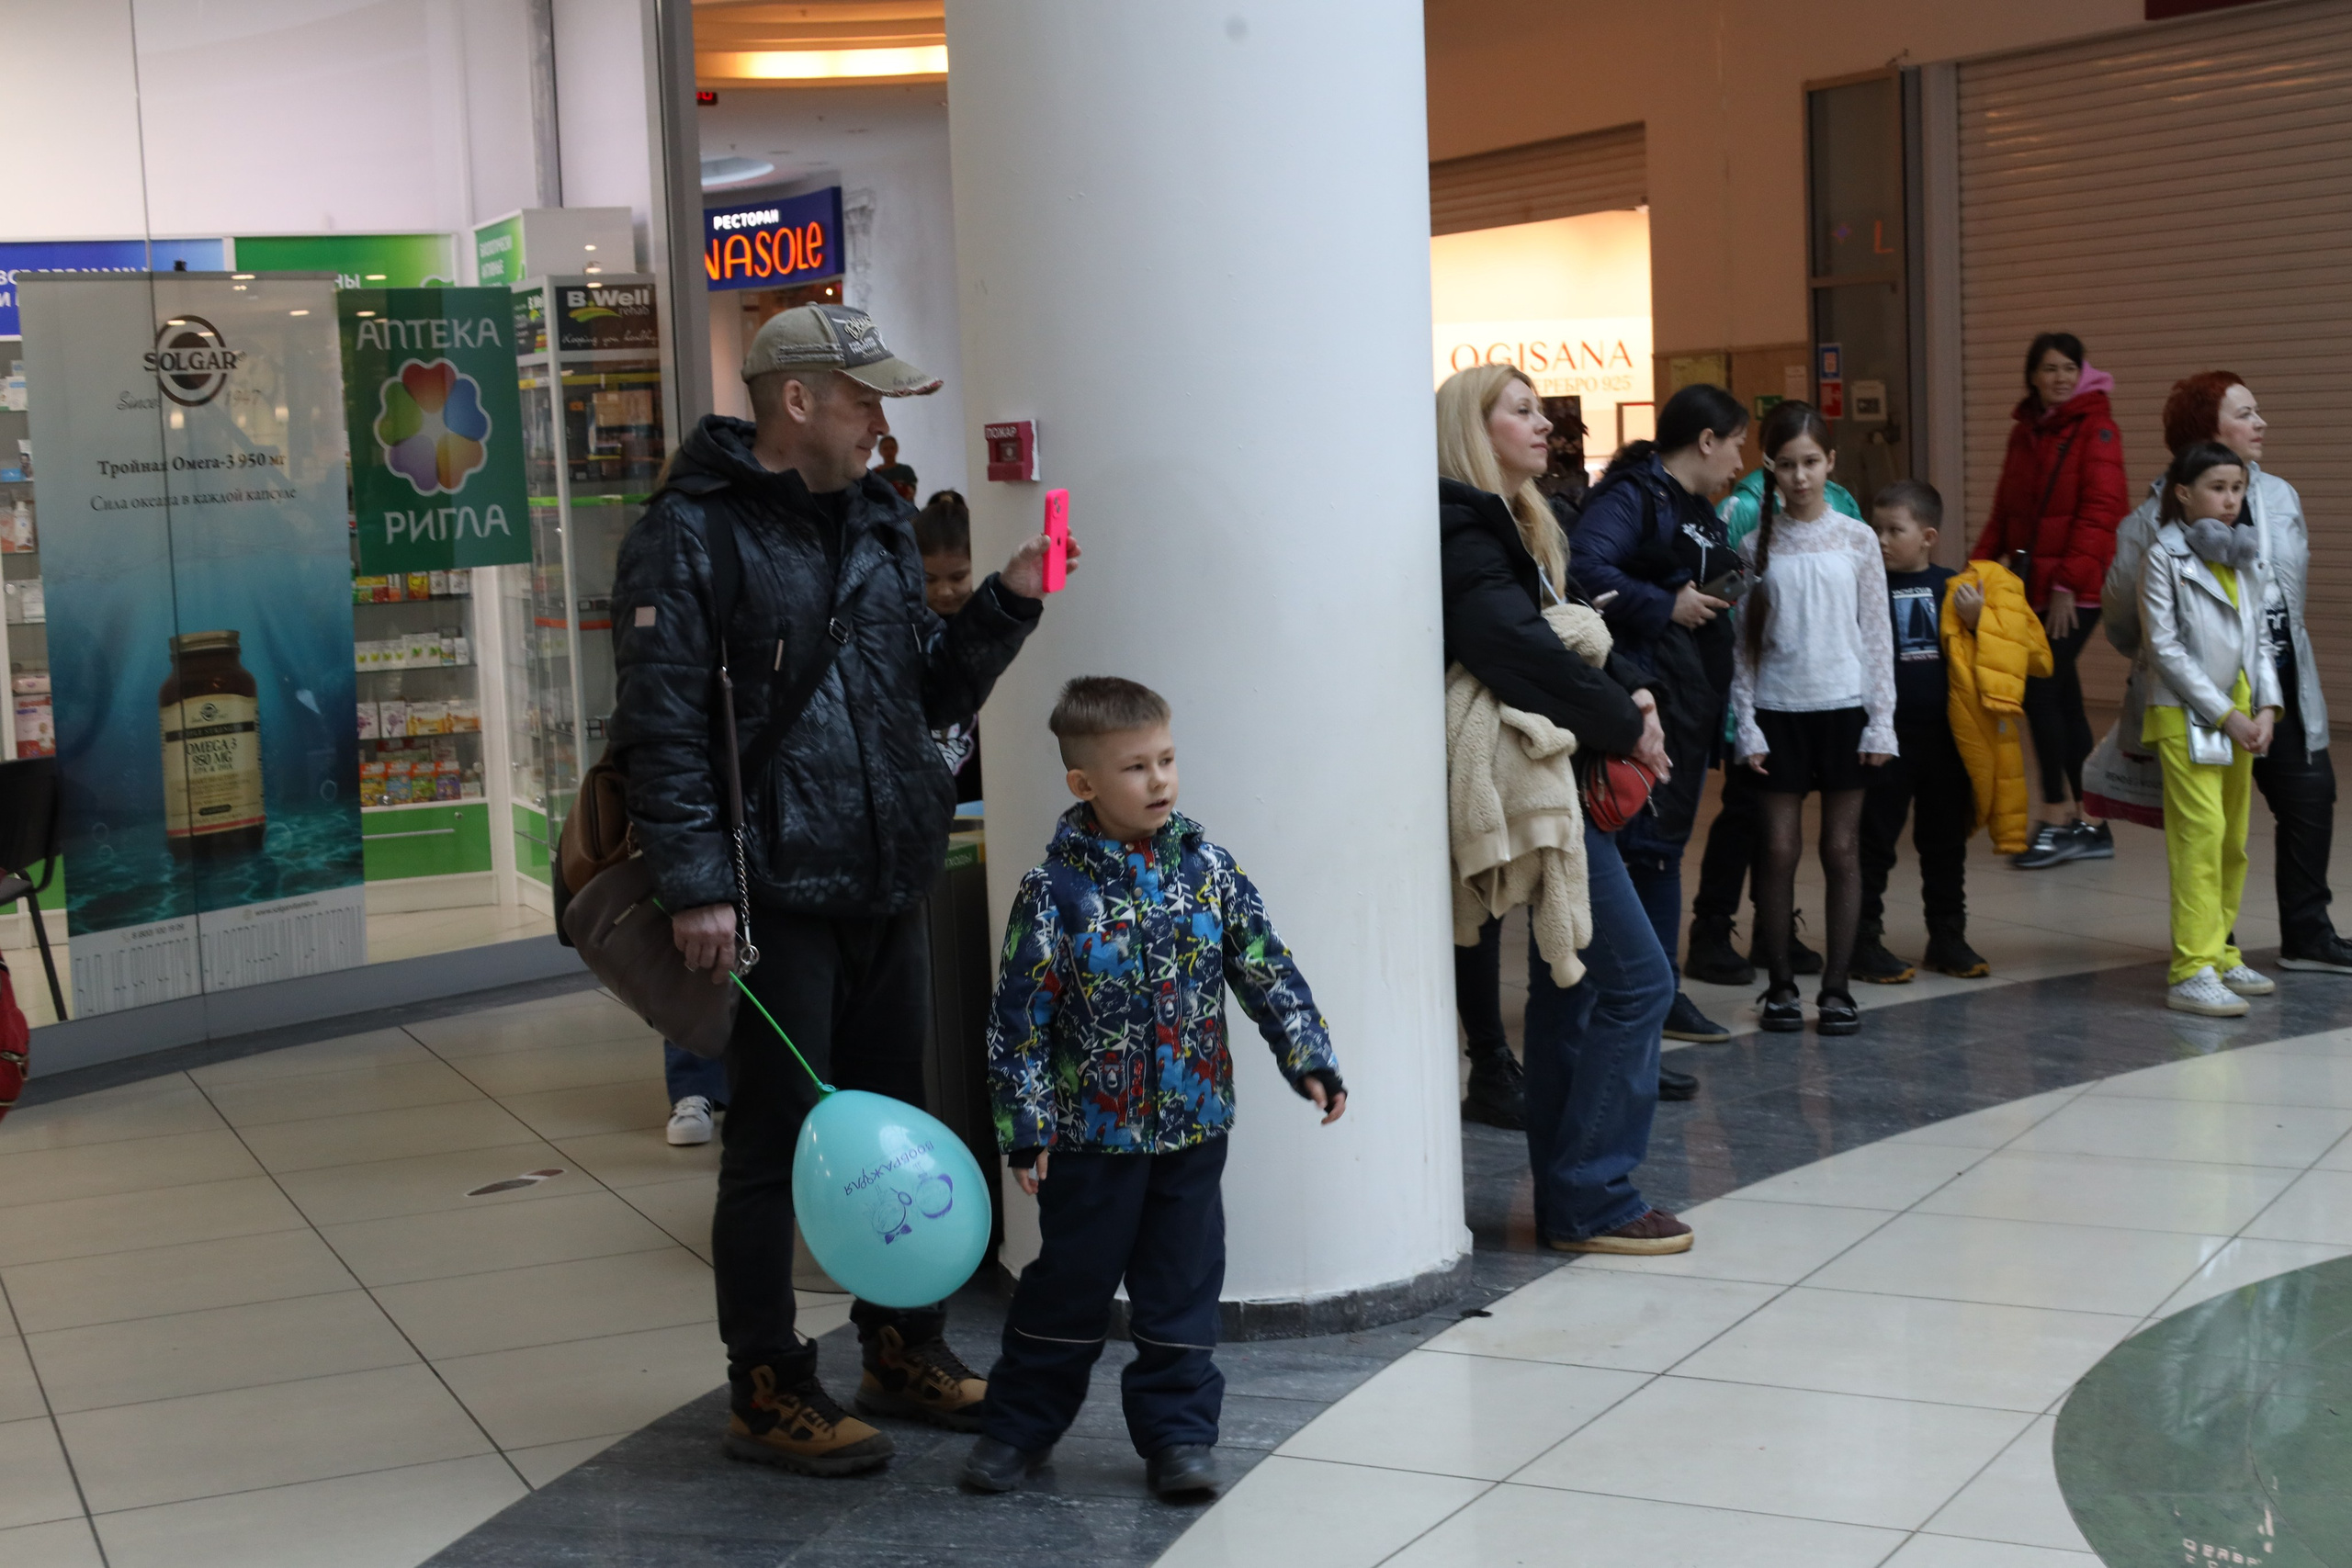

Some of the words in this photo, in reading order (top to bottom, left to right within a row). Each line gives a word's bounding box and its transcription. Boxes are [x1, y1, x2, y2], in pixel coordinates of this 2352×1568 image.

[713, 209, 780, 231] РЕСТОРАН
[567, 288, 650, 308] B.Well
[356, 317, 502, 351] АПТЕКА
[143, 351, 237, 372] SOLGAR
[1451, 338, 1634, 373] OGISANA
[1532, 377, 1598, 394] ЕРЕБРО
[984, 426, 1017, 439] ПОЖАР
[96, 458, 168, 479] Тройная
[173, 454, 235, 471] Омега-3
[238, 453, 266, 469] 950
[269, 455, 286, 466] мг
[90, 495, 129, 512] Сила
[130, 494, 178, 509] океана
[182, 496, 189, 505] в
[193, 488, 243, 505] каждой
[246, 488, 297, 505] капсуле
[383, 504, 512, 544] РИГЛА
[185, 739, 229, 755] OMEGA
[231, 737, 238, 750] 3
[214, 750, 232, 764] MG
